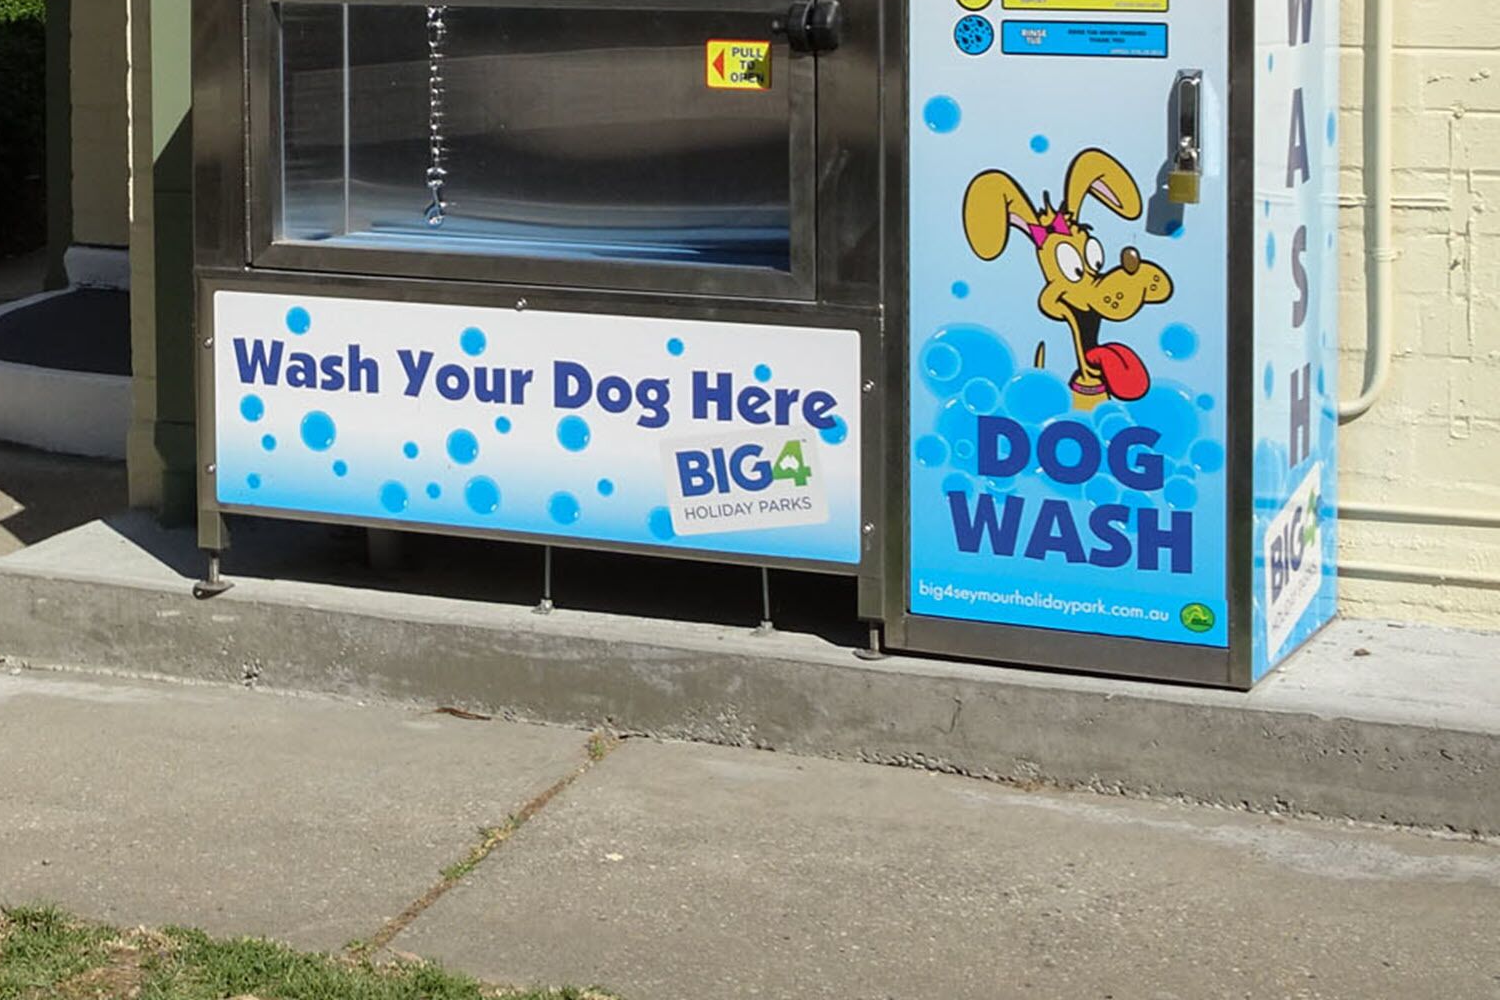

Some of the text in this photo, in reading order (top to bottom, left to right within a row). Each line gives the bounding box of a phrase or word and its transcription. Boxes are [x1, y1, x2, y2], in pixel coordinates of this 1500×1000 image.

[731, 47, 763, 58] PULL
[740, 60, 756, 70] TO
[730, 72, 764, 83] OPEN
[233, 337, 837, 429] Wash Your Dog Here
[675, 439, 812, 497] BIG4
[977, 415, 1164, 491] DOG
[684, 497, 812, 520] HOLIDAY PARKS
[947, 490, 1192, 574] WASH
[919, 579, 1170, 623] big4seymourholidaypark.com.au
